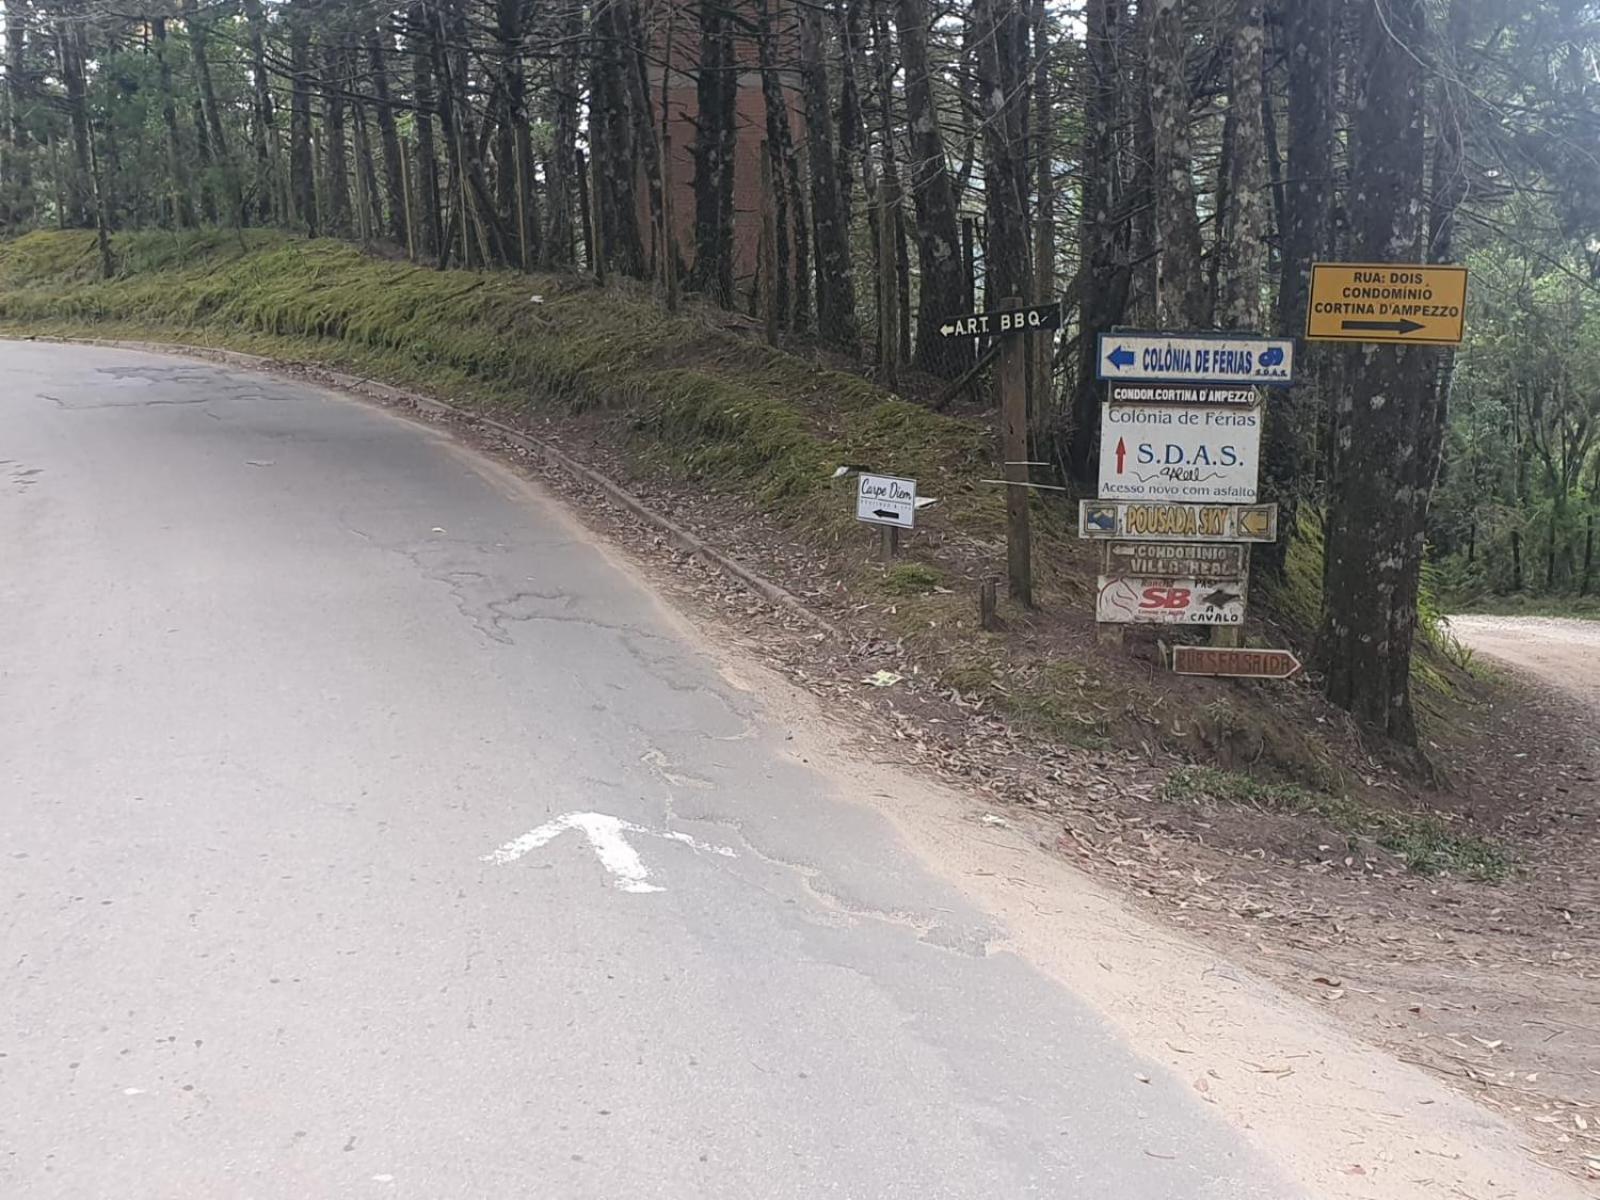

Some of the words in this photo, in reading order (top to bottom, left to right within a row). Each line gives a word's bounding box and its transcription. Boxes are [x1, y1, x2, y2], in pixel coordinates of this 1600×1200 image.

[1353, 271, 1386, 284] RUA:
[1389, 272, 1424, 285] DOIS
[1342, 285, 1433, 301] CONDOMÍNIO
[1314, 302, 1375, 315] CORTINA
[1379, 303, 1459, 318] D'AMPEZZO
[954, 316, 990, 337] A.R.T.
[1142, 342, 1191, 372] COLÔNIA
[1195, 350, 1210, 373] DE
[1213, 344, 1253, 375] FÉRIAS
[1108, 409, 1172, 425] Colônia
[1178, 411, 1199, 425] de
[1205, 411, 1257, 427] Férias
[1137, 443, 1245, 467] S.D.A.S.
[861, 478, 887, 499] Carpe
[889, 481, 912, 500] Diem
[1101, 482, 1145, 495] Acesso
[1148, 485, 1179, 496] novo
[1182, 486, 1210, 496] com
[1213, 486, 1257, 498] asfalto
[1126, 505, 1197, 536] POUSADA
[1198, 506, 1230, 536] SKY
[1138, 587, 1192, 609] SB
[1190, 612, 1239, 623] CAVALO
